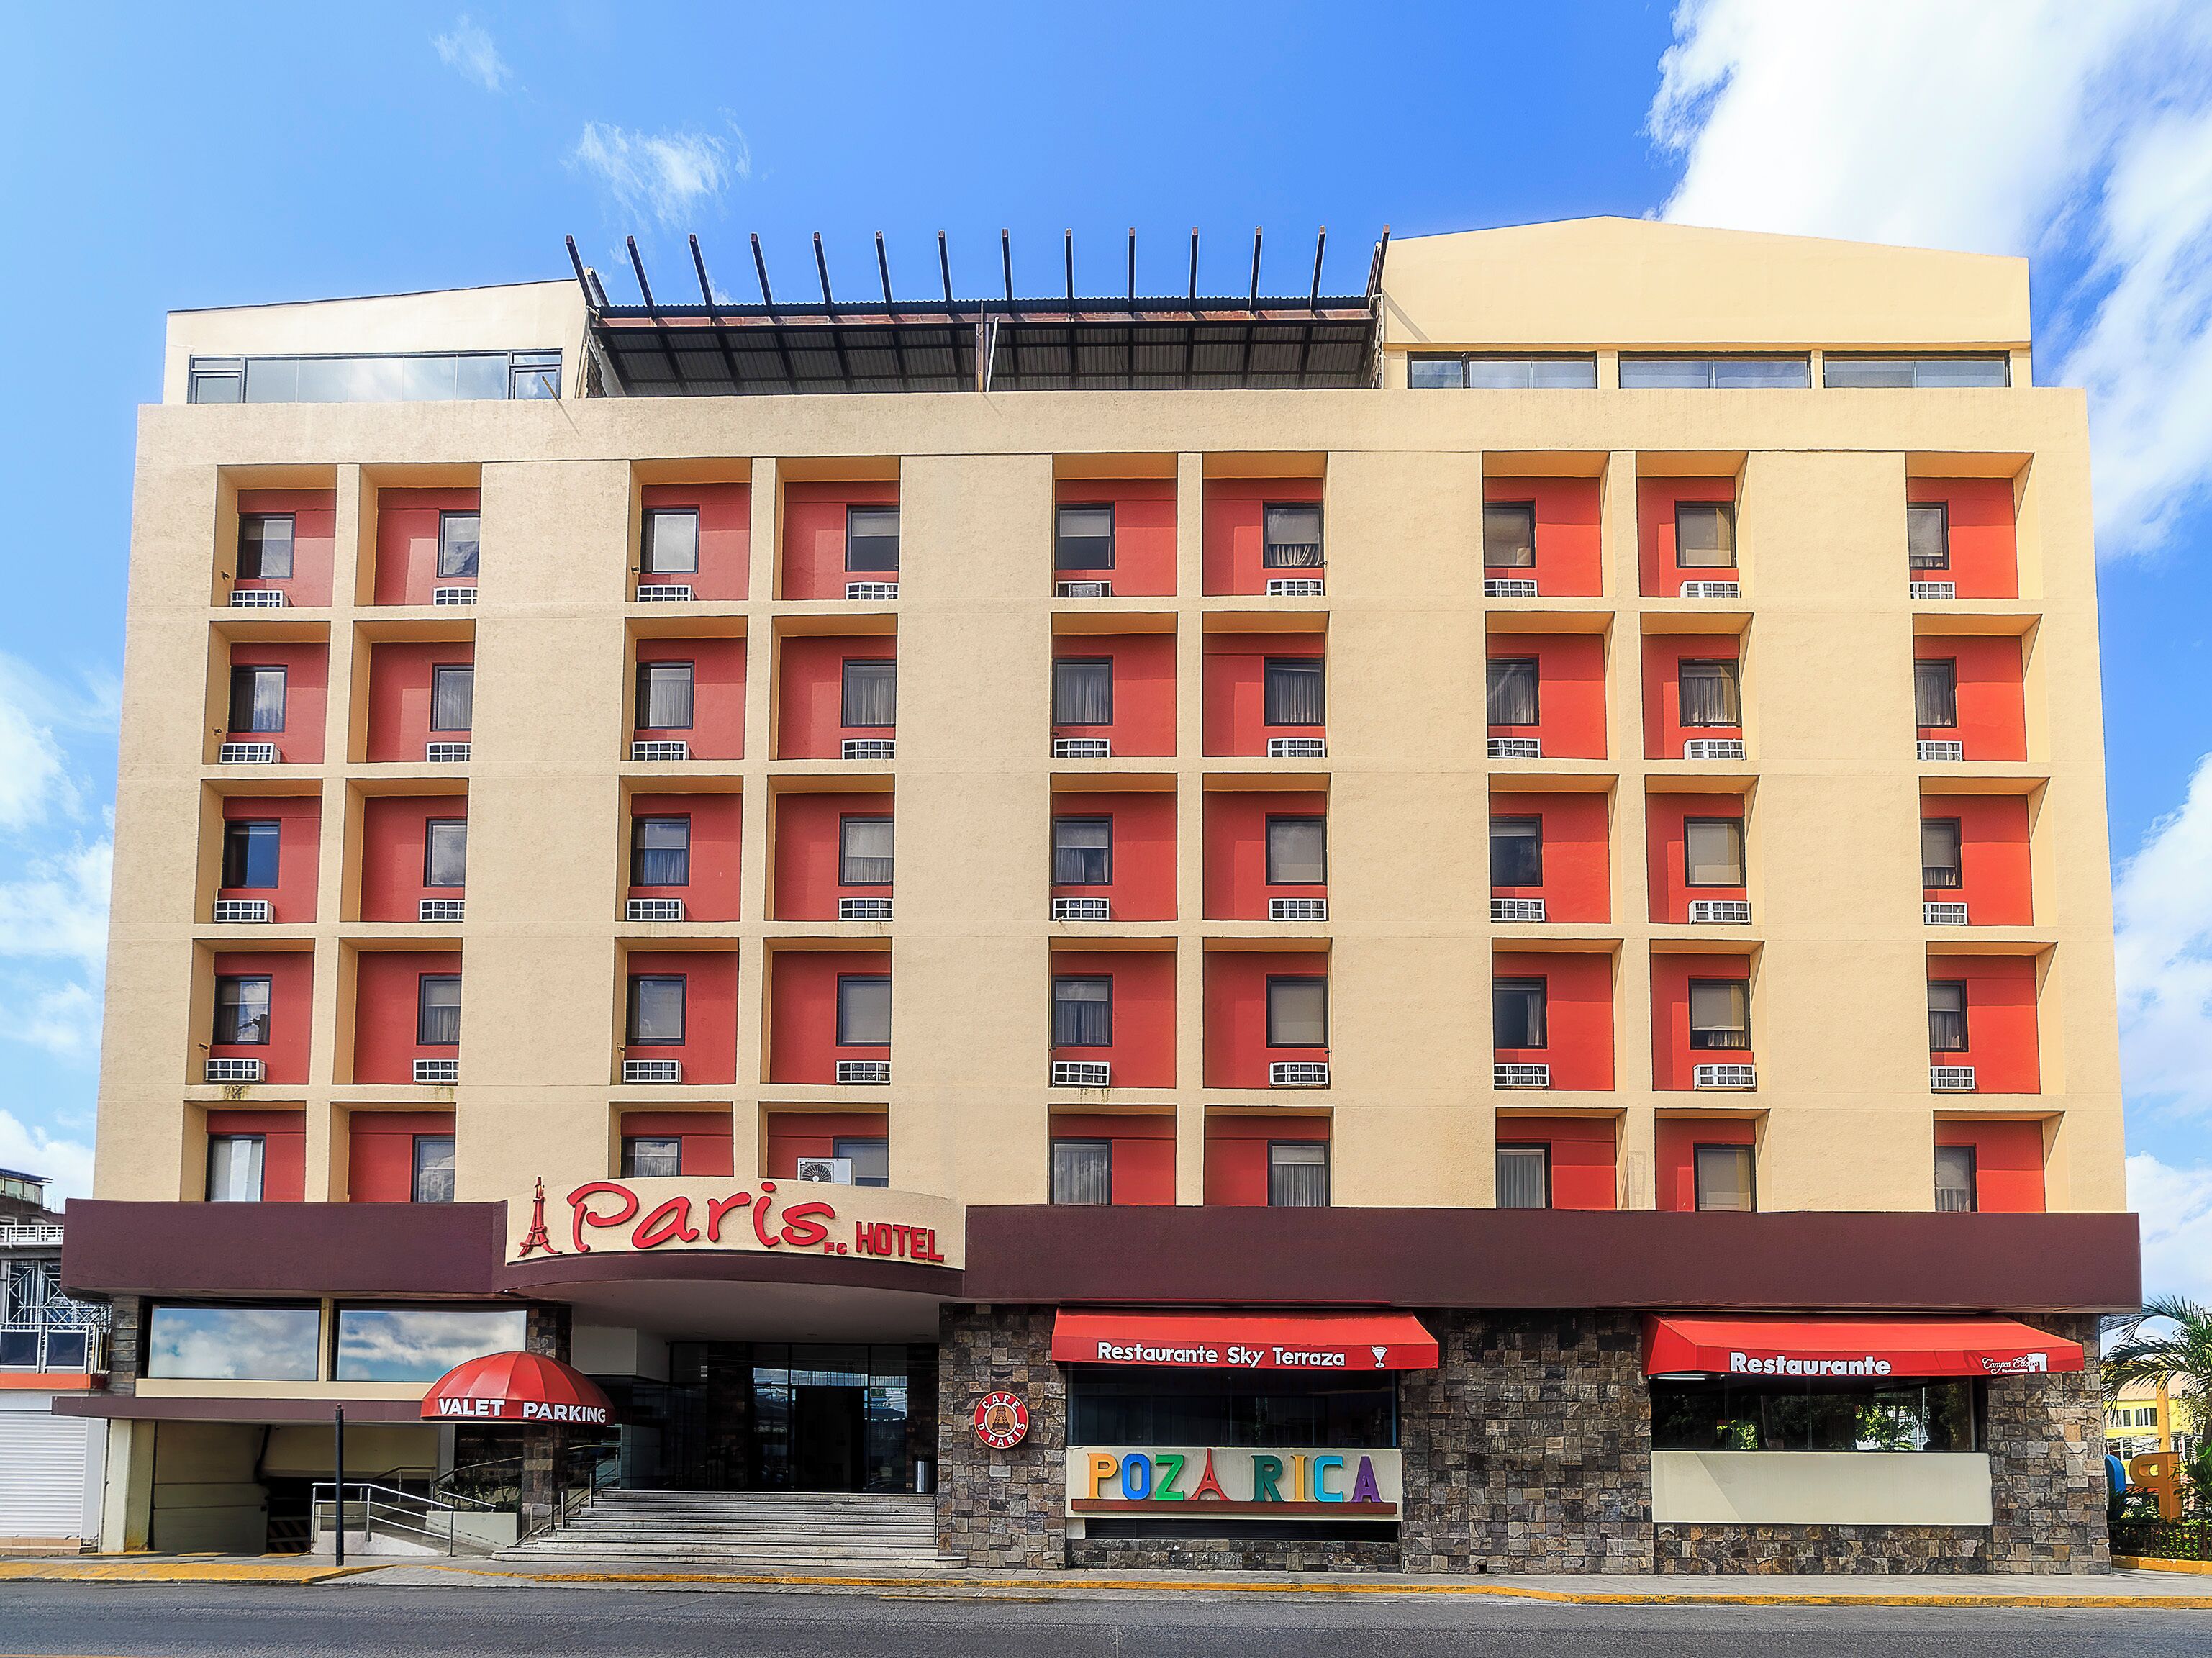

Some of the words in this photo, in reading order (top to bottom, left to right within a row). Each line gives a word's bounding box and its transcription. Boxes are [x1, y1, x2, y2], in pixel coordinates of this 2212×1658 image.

[566, 1182, 836, 1253] Paris
[856, 1220, 944, 1262] HOTEL
[1097, 1341, 1218, 1364] Restaurante
[1226, 1346, 1265, 1368] Sky
[1272, 1346, 1346, 1367] Terraza
[1729, 1351, 1892, 1376] Restaurante
[438, 1398, 506, 1417] VALET
[522, 1402, 607, 1424] PARKING
[982, 1394, 1021, 1410] CAFE
[1086, 1448, 1233, 1502] POZA
[1250, 1455, 1386, 1503] RICA
